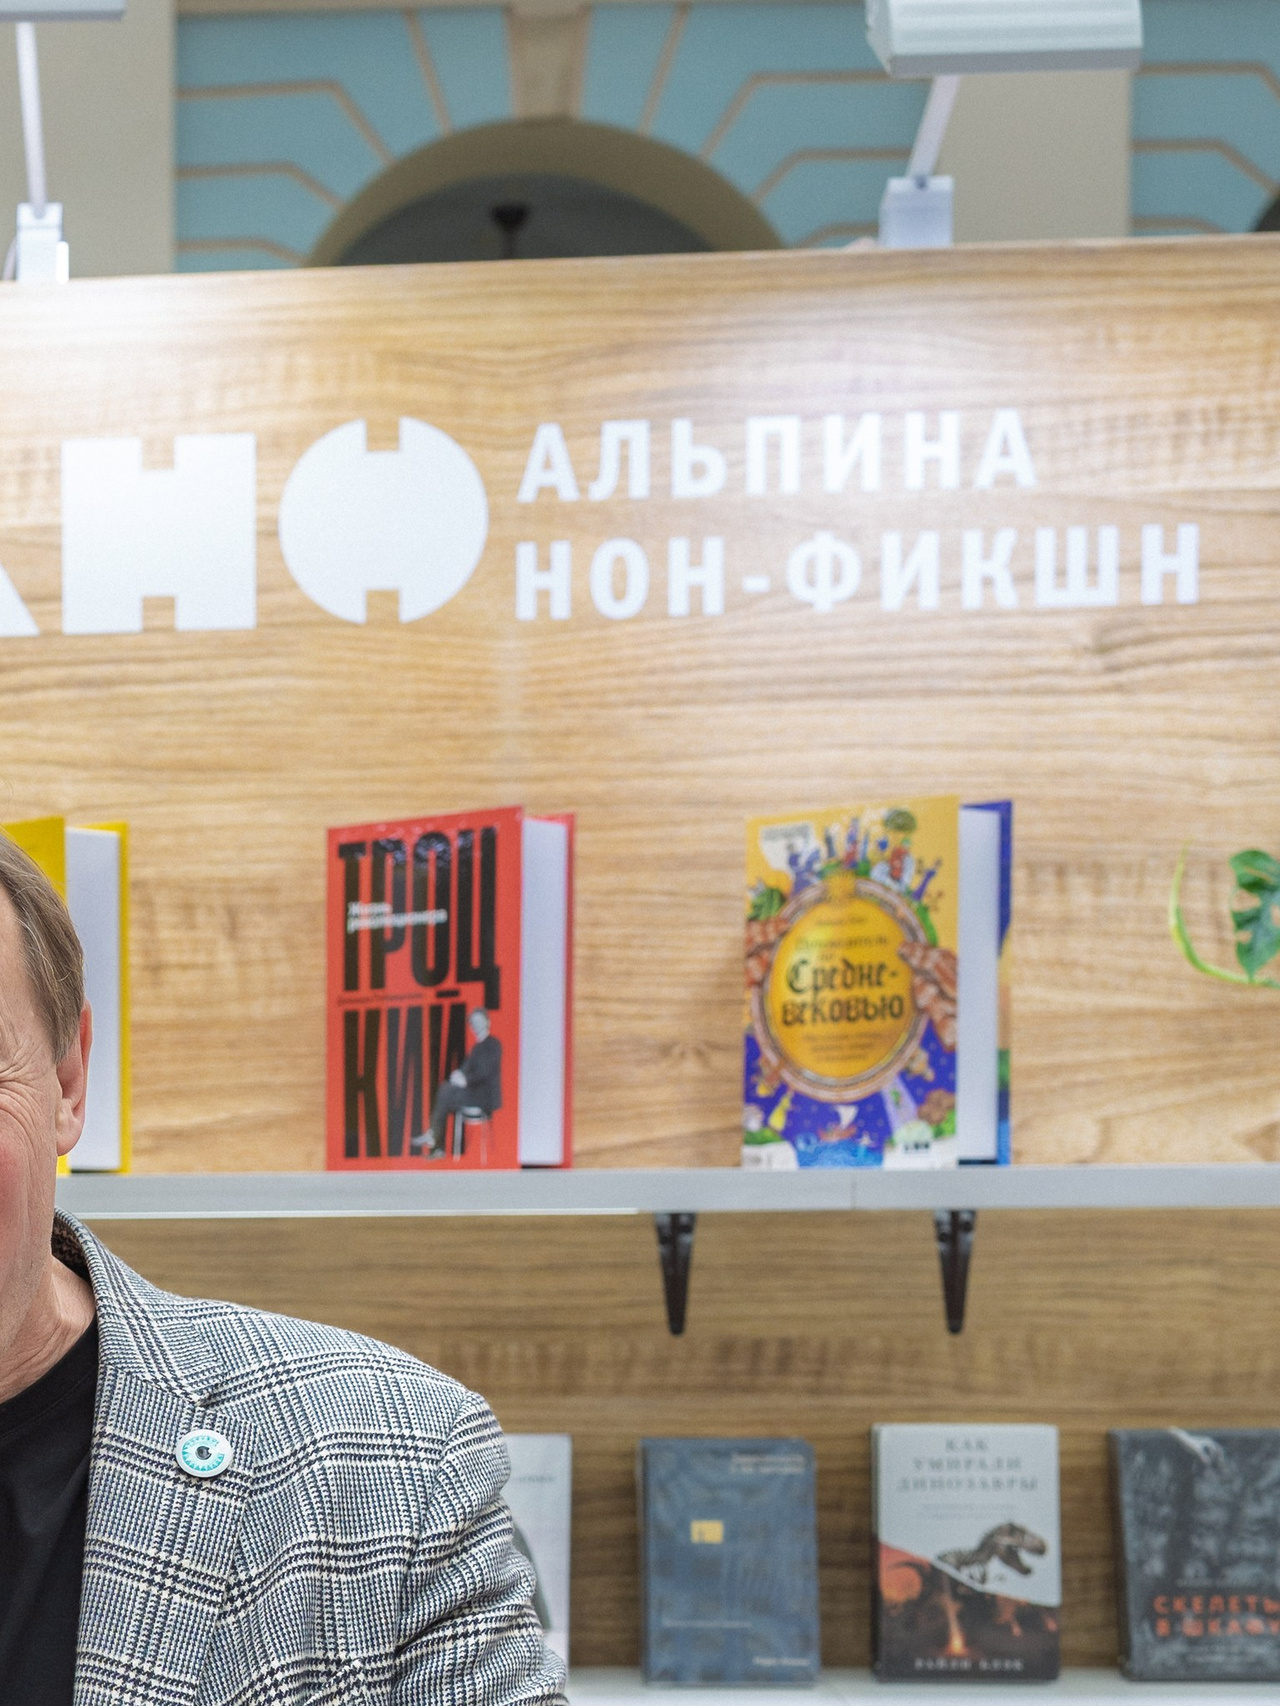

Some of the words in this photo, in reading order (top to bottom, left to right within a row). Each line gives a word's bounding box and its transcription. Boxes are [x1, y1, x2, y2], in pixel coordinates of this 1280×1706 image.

[516, 409, 1038, 503] АЛЬПИНА
[516, 523, 1200, 620] НОН-ФИКШН
[339, 827, 500, 1010] ТРОЦ
[782, 994, 904, 1028] вековью
[787, 957, 898, 996] Средне-
